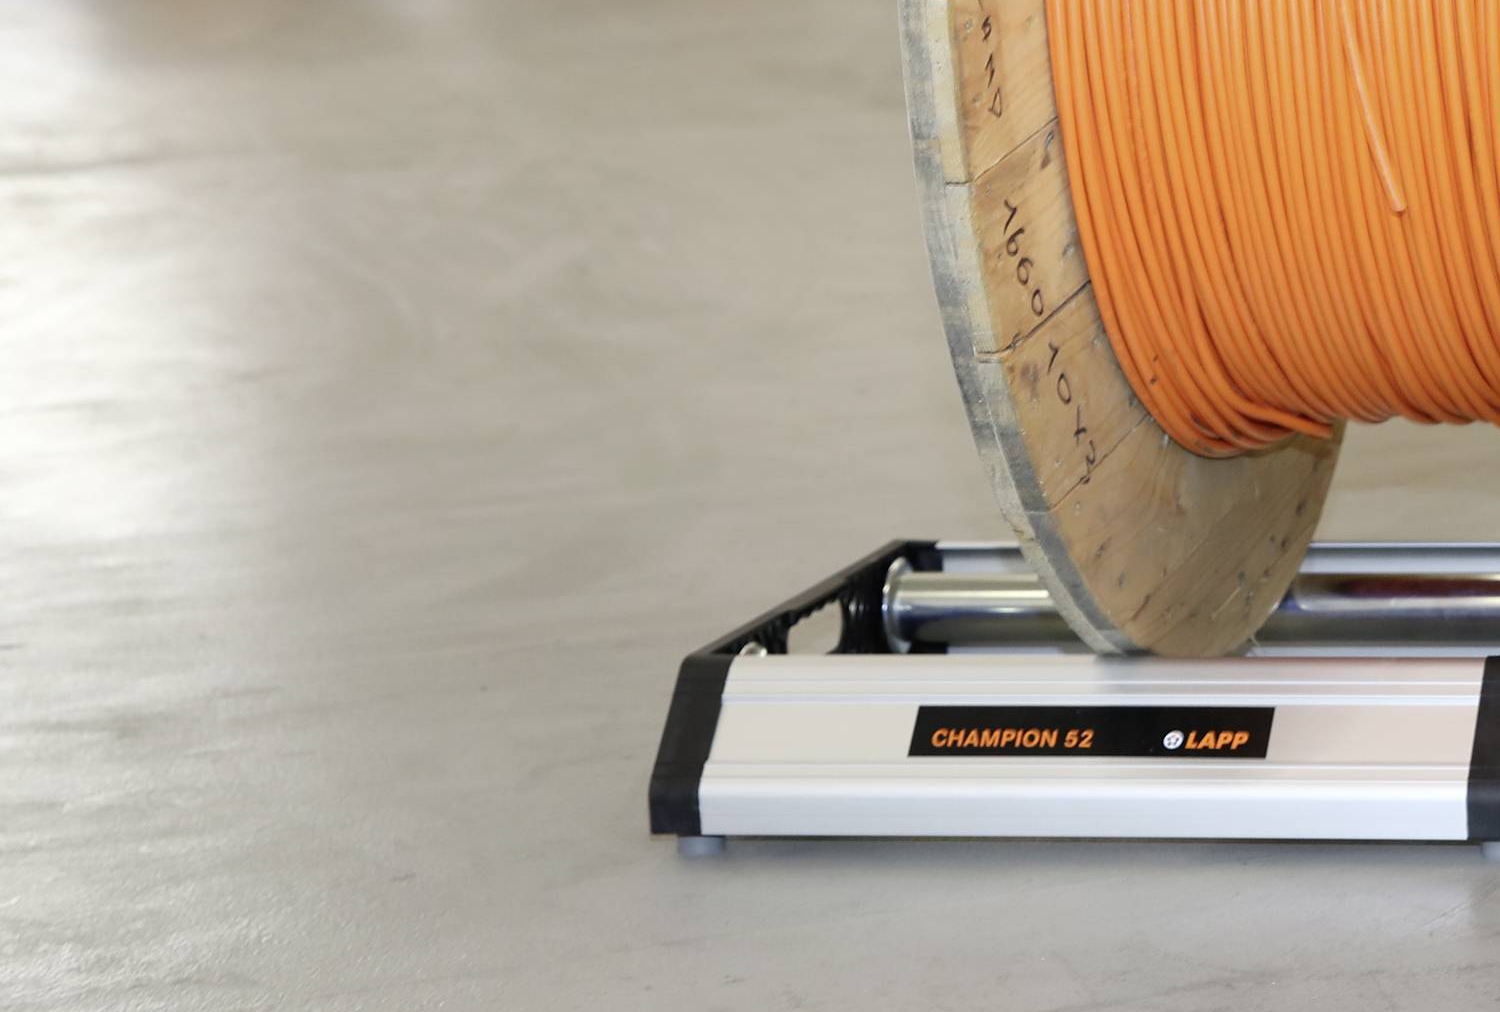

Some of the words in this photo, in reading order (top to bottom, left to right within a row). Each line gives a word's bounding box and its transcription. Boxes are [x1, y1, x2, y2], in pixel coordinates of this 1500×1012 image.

[931, 728, 1058, 748] CHAMPION
[1064, 729, 1094, 748] 52
[1184, 731, 1249, 749] LAPP
